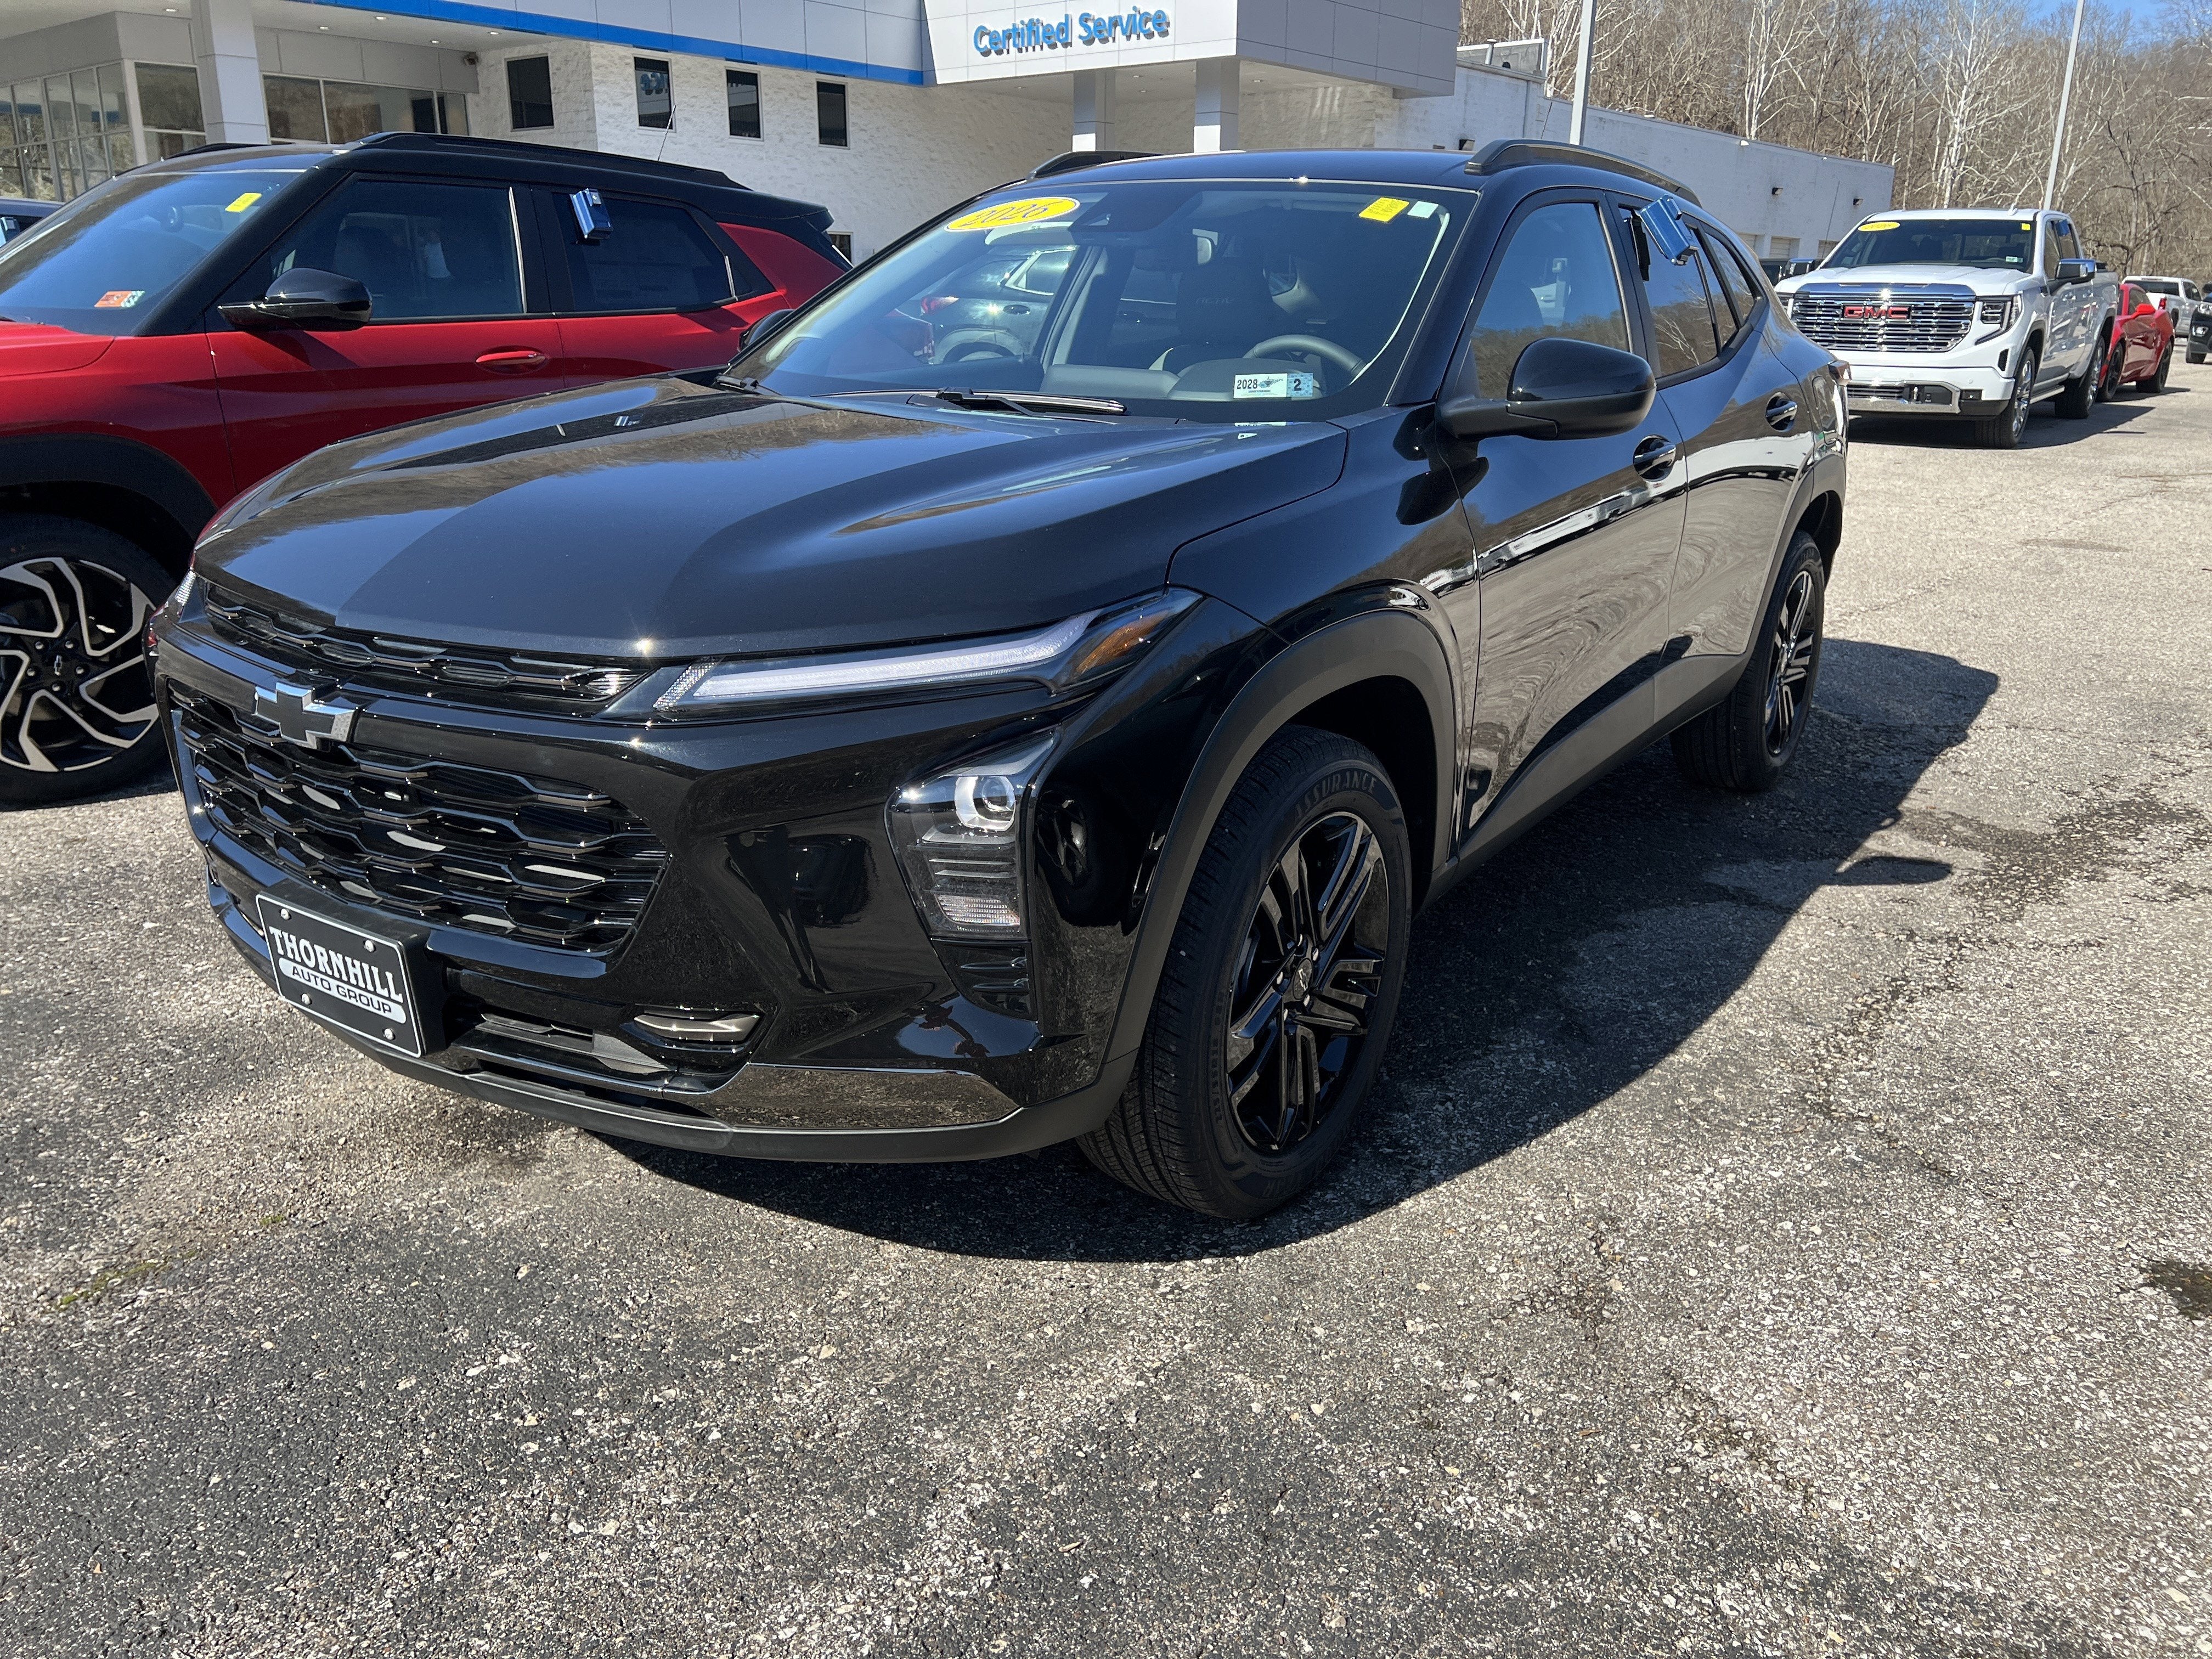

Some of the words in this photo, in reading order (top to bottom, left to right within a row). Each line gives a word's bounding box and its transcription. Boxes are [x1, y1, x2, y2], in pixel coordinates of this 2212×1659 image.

[973, 14, 1071, 53] Certified
[1079, 5, 1167, 41] Service
[957, 201, 1063, 227] 2026
[1844, 306, 1908, 318] GMC
[1237, 379, 1257, 390] 2028
[1294, 379, 1302, 391] 2
[1294, 770, 1377, 821] ASSURANCE
[269, 926, 403, 1003] THORNHILL
[292, 966, 331, 991] AUTO
[336, 985, 392, 1014] GROUP
